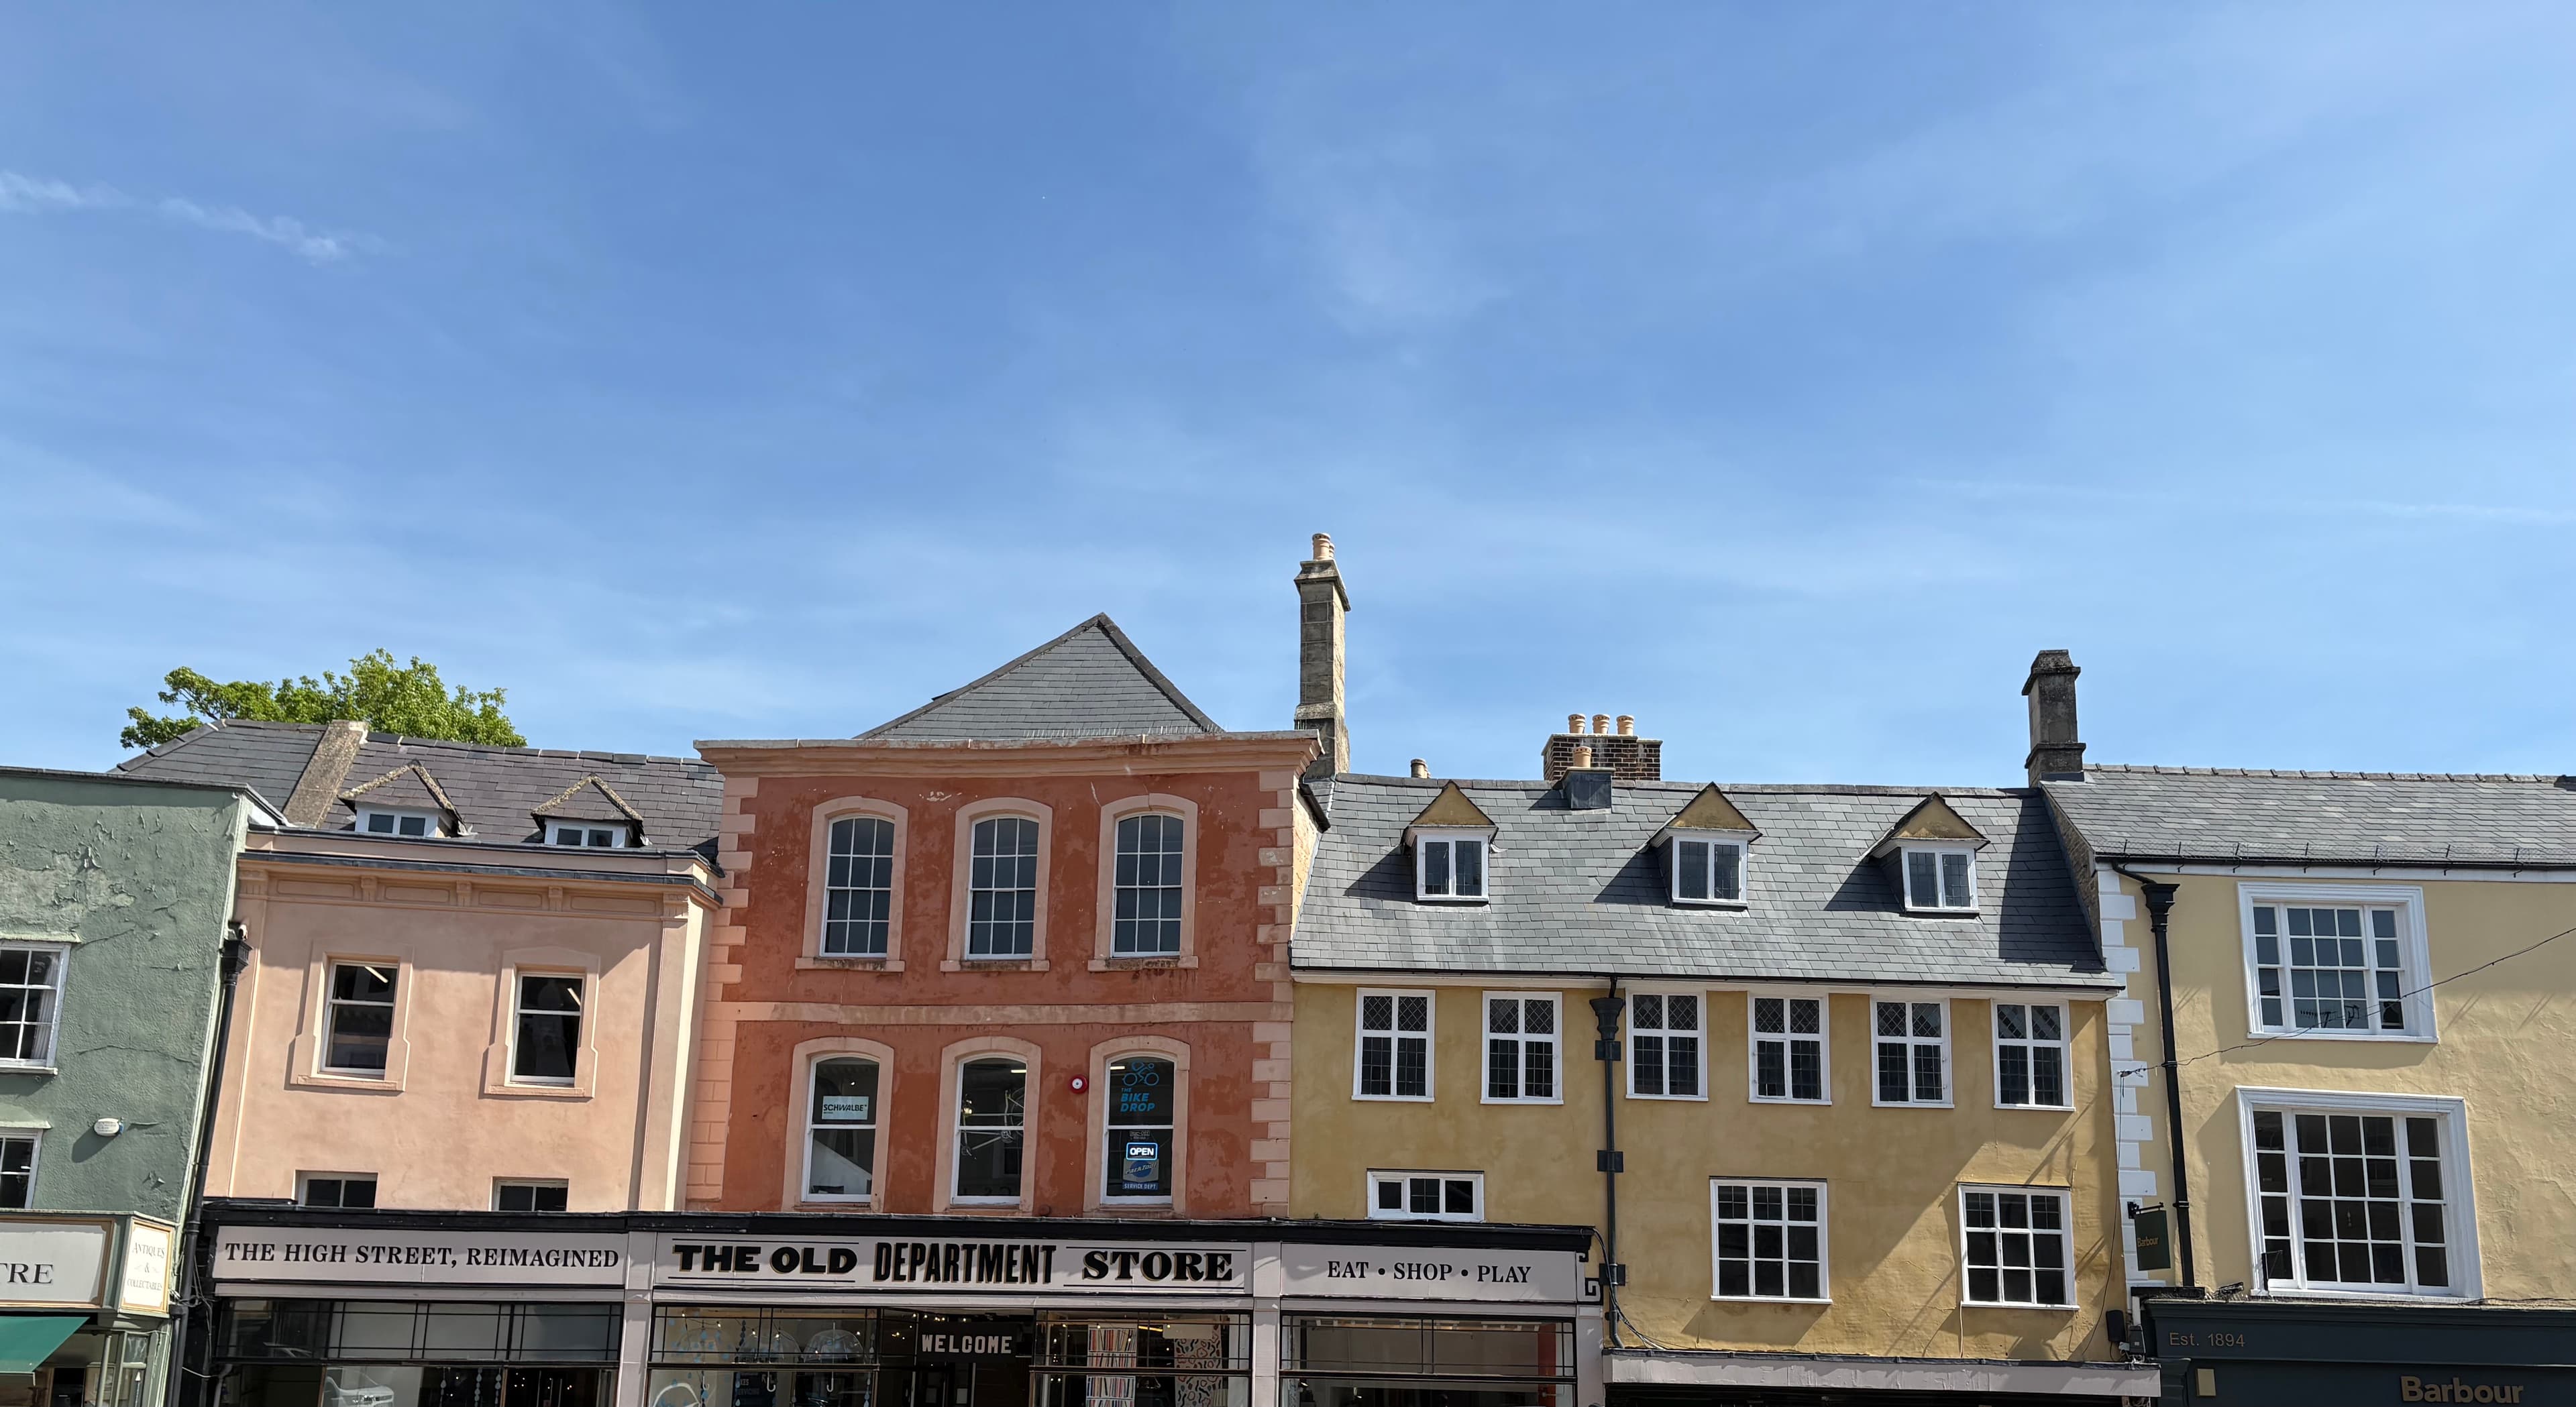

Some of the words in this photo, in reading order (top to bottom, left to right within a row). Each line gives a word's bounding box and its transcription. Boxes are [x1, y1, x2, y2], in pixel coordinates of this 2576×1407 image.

[1121, 1092, 1150, 1102] BIKE
[1120, 1103, 1156, 1112] DROP
[1130, 1147, 1155, 1156] OPEN
[132, 1241, 165, 1259] ANTIQUES
[2137, 1236, 2159, 1247] Barbour
[225, 1243, 275, 1261] THE
[283, 1243, 348, 1263] HIGH
[355, 1245, 458, 1269] STREET,
[466, 1247, 619, 1268] REIMAGINED
[672, 1244, 762, 1274] THE
[769, 1245, 859, 1276] OLD
[873, 1242, 1057, 1284] DEPARTMENT
[1081, 1250, 1233, 1282] STORE
[144, 1261, 150, 1274] &
[1328, 1260, 1370, 1279] EAT
[1393, 1262, 1454, 1282] SHOP
[1477, 1264, 1532, 1284] PLAY
[921, 1334, 1013, 1354] WELCOME
[2169, 1332, 2200, 1347] Est.
[2208, 1333, 2246, 1348] 1894
[2400, 1375, 2524, 1404] Barbour
